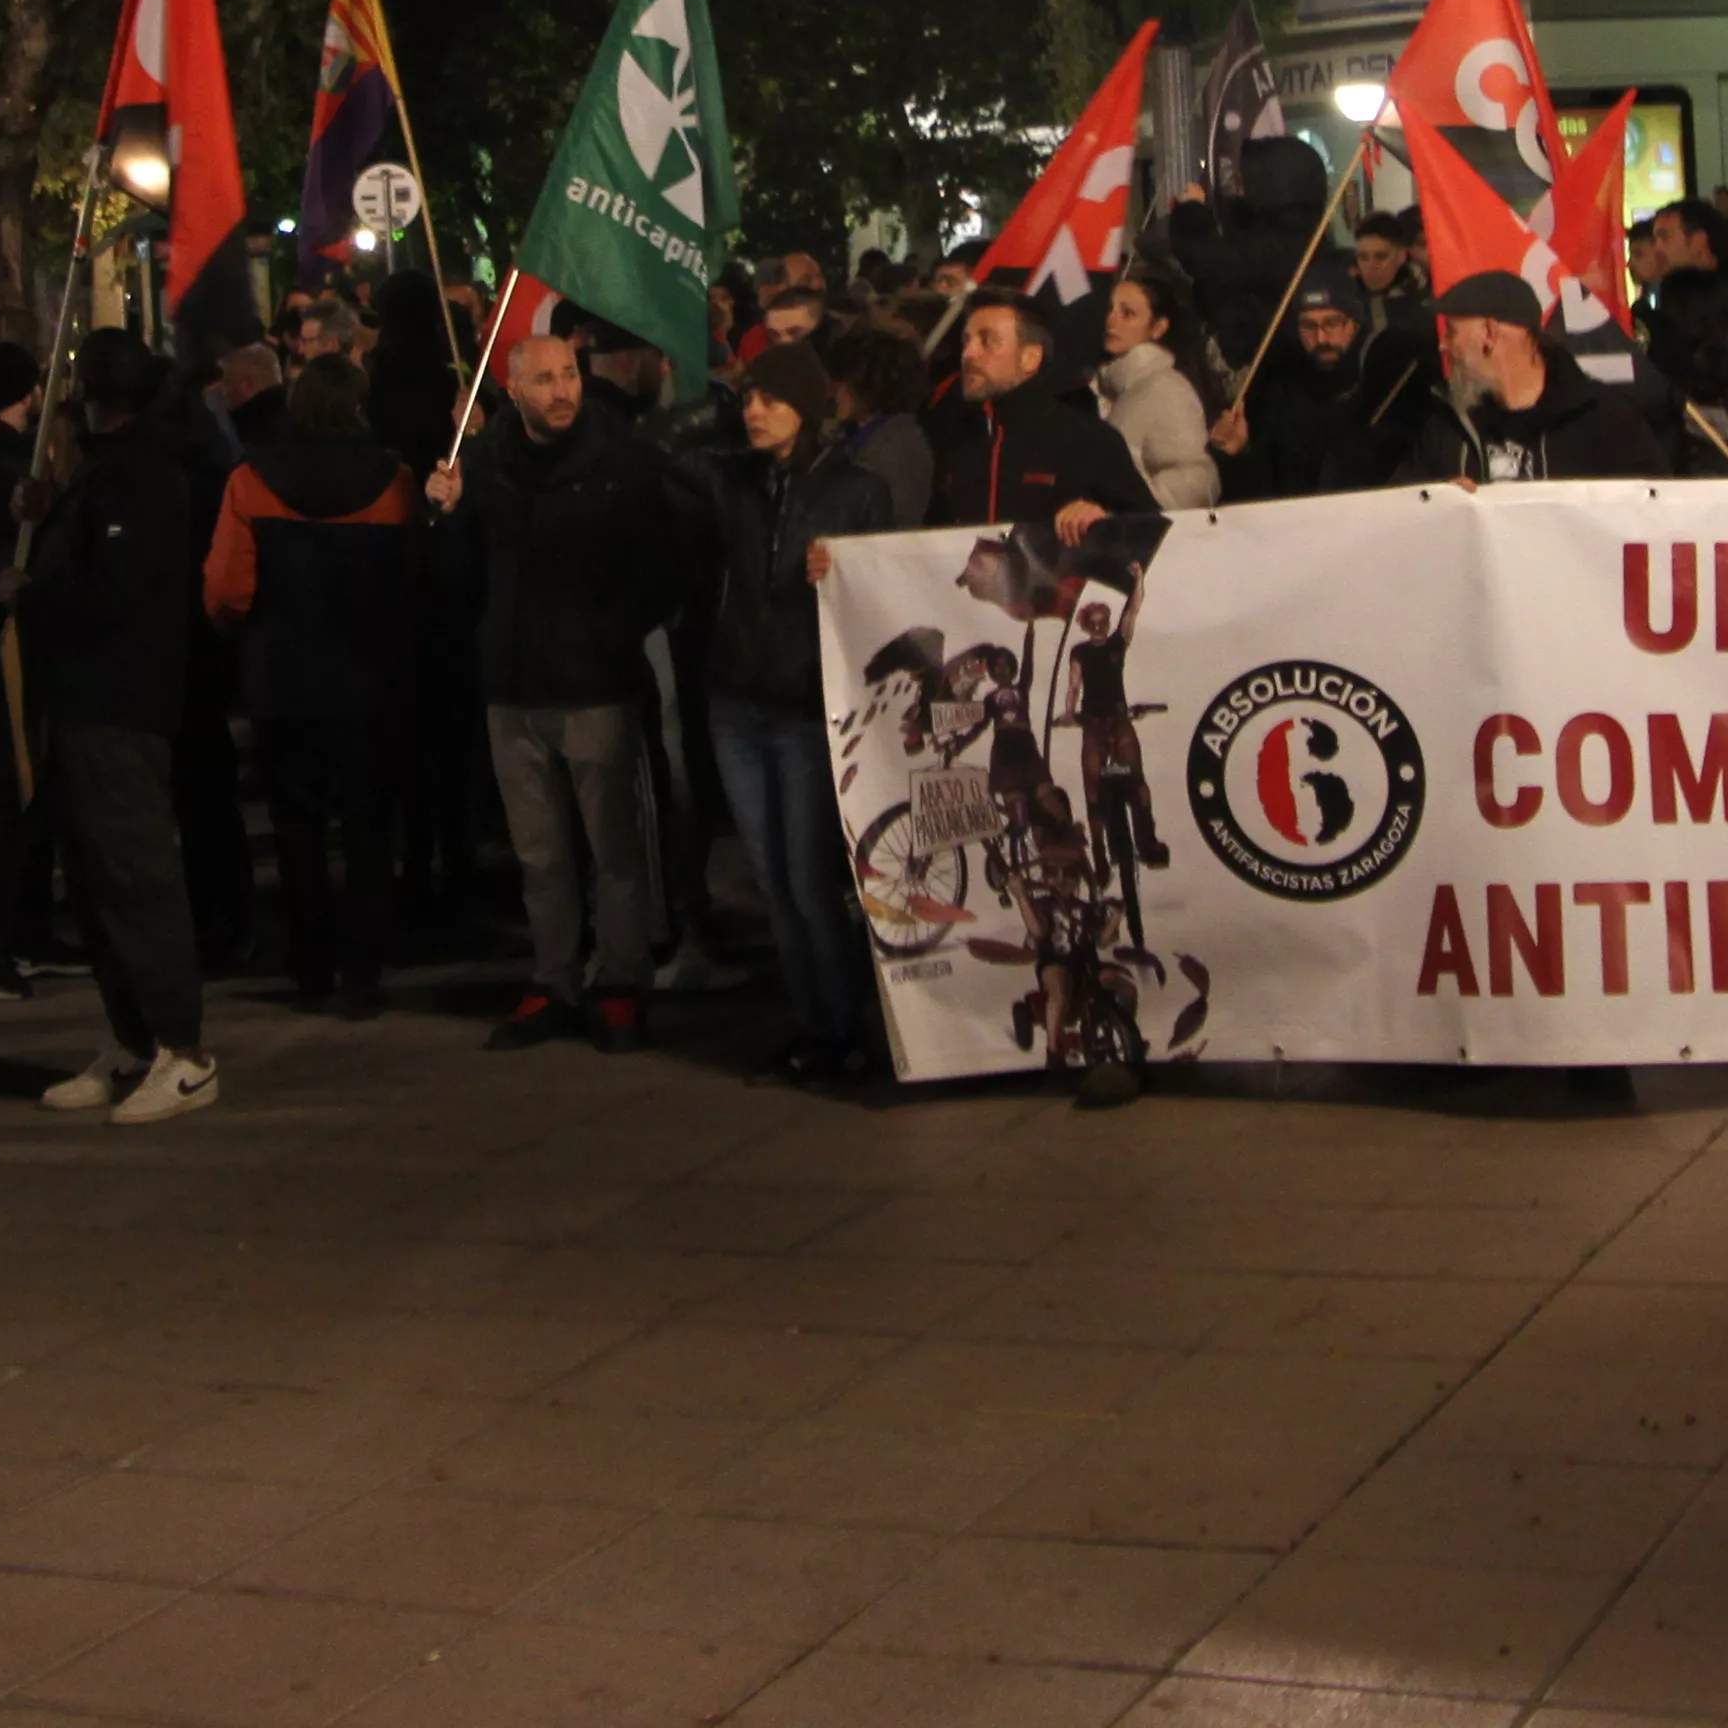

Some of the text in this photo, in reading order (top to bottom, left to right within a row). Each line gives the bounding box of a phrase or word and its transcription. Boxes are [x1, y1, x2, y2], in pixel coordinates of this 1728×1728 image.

[1202, 668, 1399, 759] ABSOLUCIÓN
[1208, 803, 1413, 891] ANTIFASCISTAS ZARAGOZA
